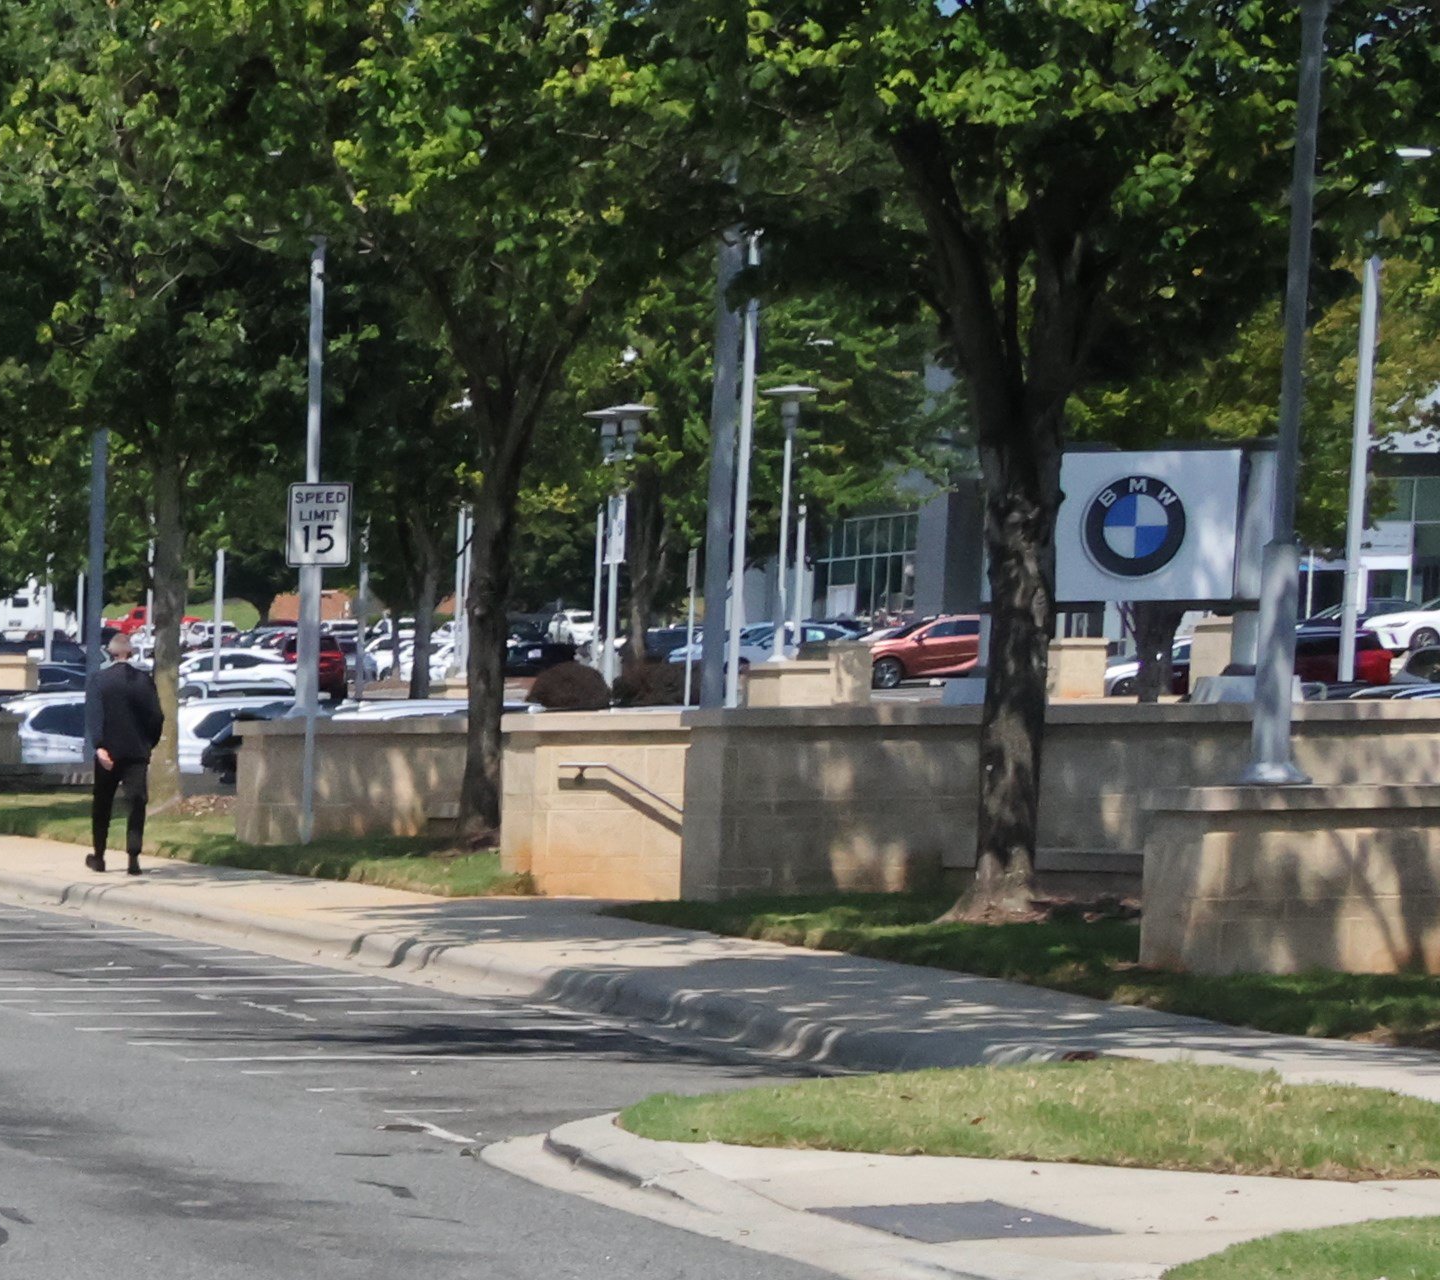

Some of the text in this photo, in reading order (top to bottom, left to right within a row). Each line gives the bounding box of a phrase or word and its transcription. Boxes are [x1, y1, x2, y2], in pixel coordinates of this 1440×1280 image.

[295, 491, 346, 504] SPEED
[1098, 478, 1178, 508] BMW
[299, 509, 339, 522] LIMIT
[302, 525, 335, 554] 15
